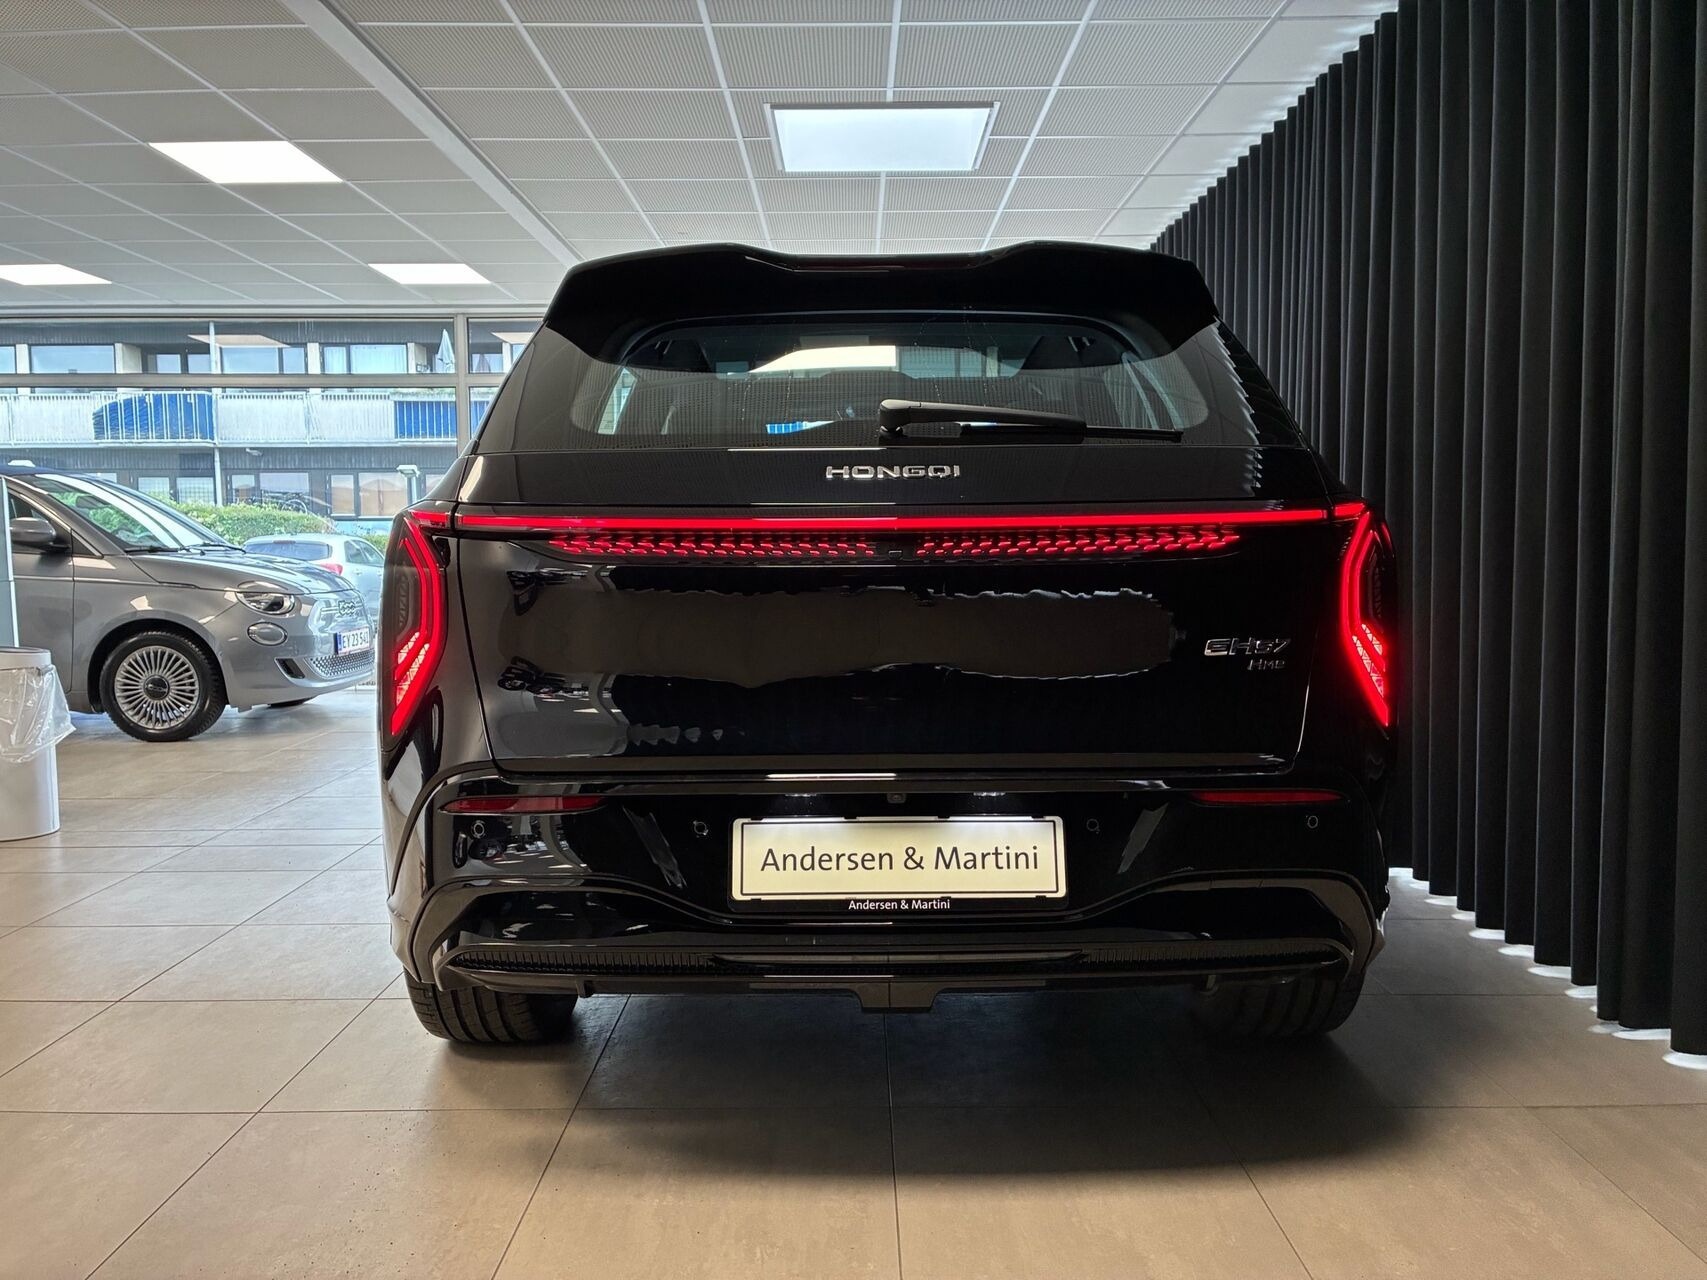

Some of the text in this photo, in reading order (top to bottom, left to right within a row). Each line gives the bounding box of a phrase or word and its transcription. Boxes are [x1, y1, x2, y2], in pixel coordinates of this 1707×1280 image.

[826, 465, 961, 479] HONGQI
[1204, 637, 1292, 656] EHS7
[760, 845, 1038, 872] Andersen & Martini
[848, 899, 950, 910] Andersen & Martini
